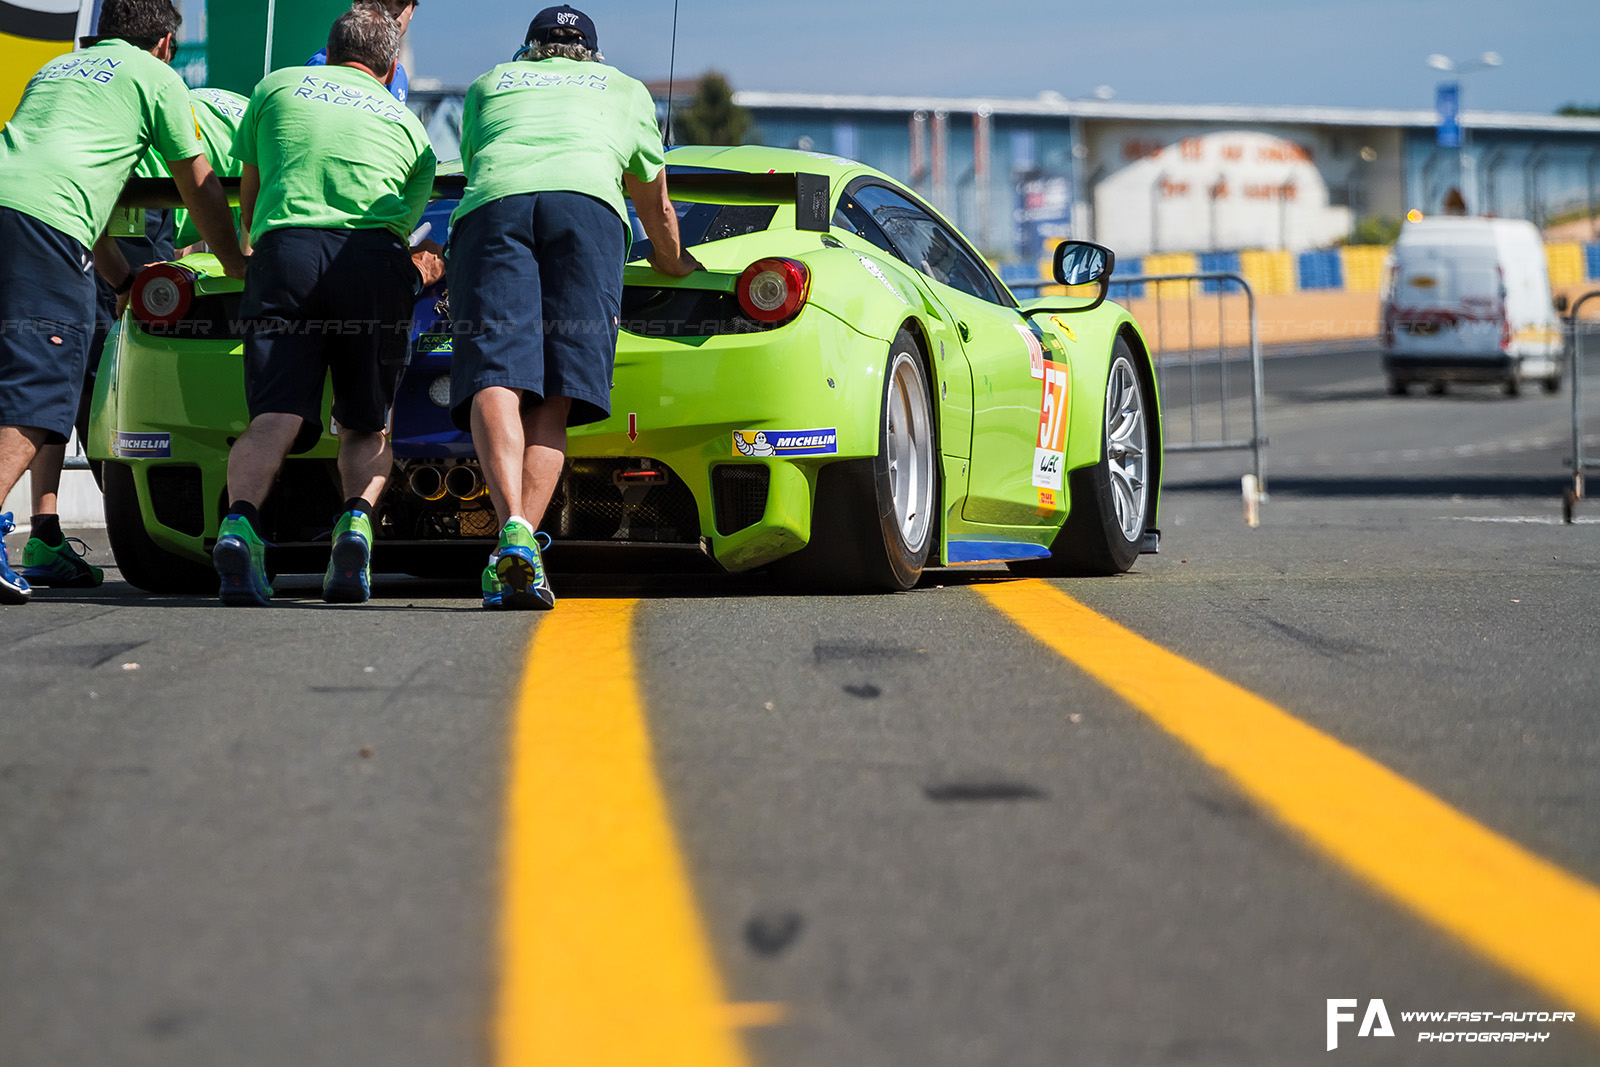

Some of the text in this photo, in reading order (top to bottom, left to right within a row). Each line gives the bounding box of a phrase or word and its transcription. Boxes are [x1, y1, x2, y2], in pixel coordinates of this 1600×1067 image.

[500, 71, 608, 82] KROHN
[495, 80, 608, 91] RACING
[302, 75, 404, 115] KROHN
[294, 86, 402, 122] RACING
[1040, 367, 1067, 450] 57
[120, 439, 169, 449] MICHELIN
[776, 434, 836, 447] MICHELIN
[1040, 454, 1059, 473] WEC
